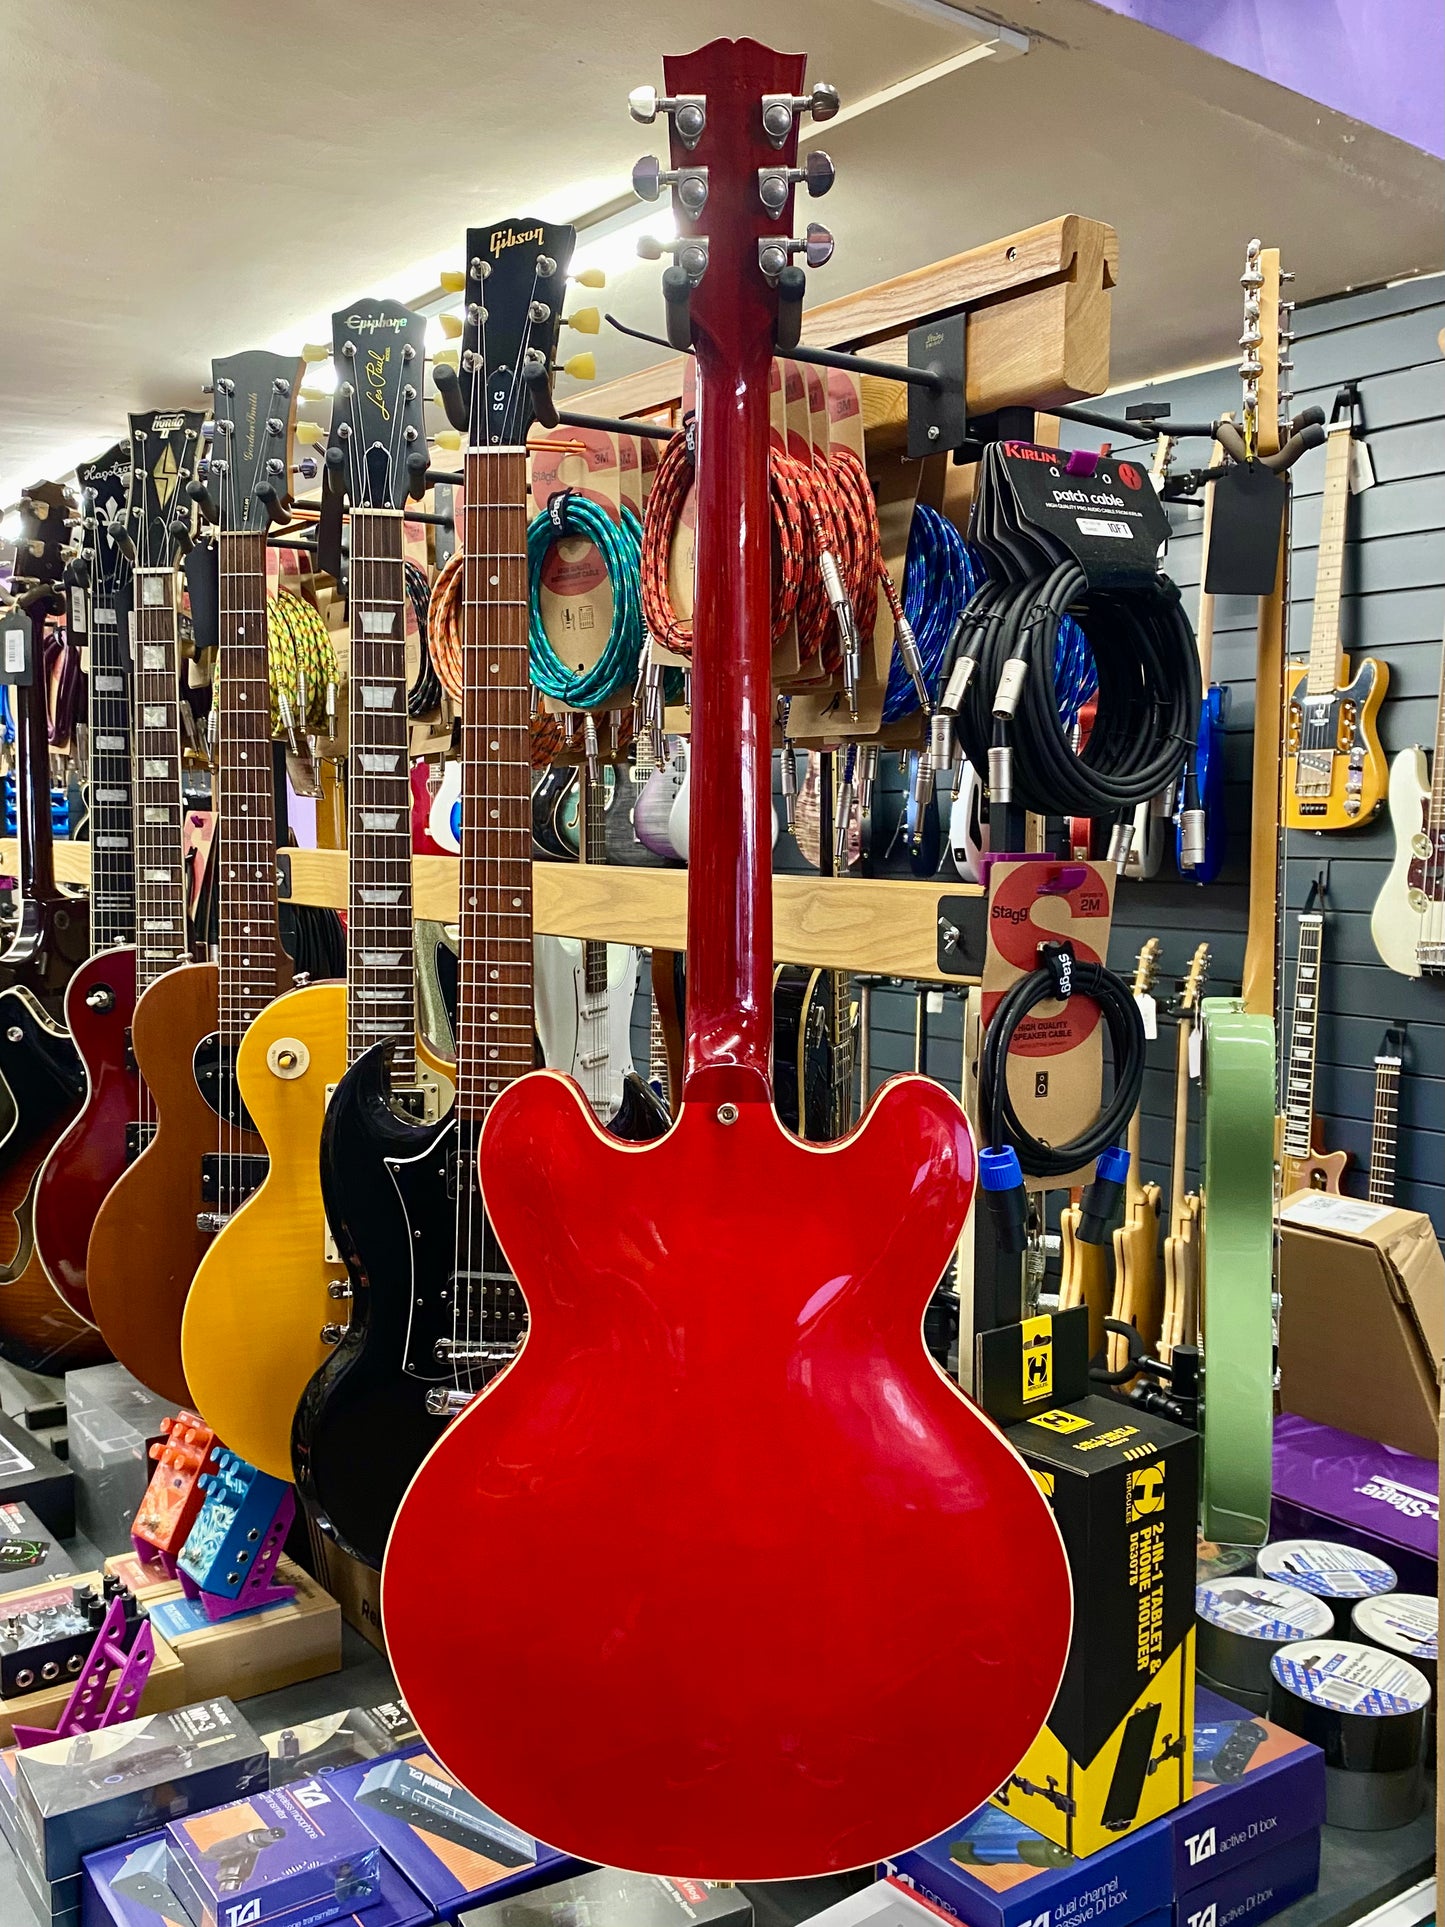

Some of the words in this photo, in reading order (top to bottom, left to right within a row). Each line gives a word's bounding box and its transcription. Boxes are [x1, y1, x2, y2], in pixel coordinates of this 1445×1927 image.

[490, 226, 544, 259] Gibson
[344, 313, 408, 335] Epiphone
[365, 349, 387, 388] Paul
[493, 391, 505, 411] SG
[1004, 443, 1057, 463] KIRLIN
[532, 468, 558, 485] Stagg
[1052, 489, 1089, 505] patch
[1090, 492, 1125, 508] cable
[1107, 523, 1129, 535] 10FT
[991, 906, 1028, 925] Stagg
[1080, 899, 1100, 912] 2M
[1058, 953, 1072, 994] Stagg
[1013, 1031, 1047, 1042] SPEAKER
[1048, 1029, 1072, 1039] CABLE
[1018, 1022, 1036, 1032] HIGH
[1038, 1021, 1068, 1031] QUALITY
[1129, 1532, 1139, 1586] DG307B
[1138, 1526, 1152, 1593] PHONE
[1152, 1522, 1165, 1582] 2-IN-1
[1151, 1585, 1164, 1652] TABLET
[1137, 1595, 1151, 1672] HOLDER
[1149, 1658, 1162, 1675] &
[187, 1706, 217, 1732] MP-3
[210, 1703, 232, 1726] NUX
[1184, 1827, 1216, 1866] TGI
[1219, 1833, 1246, 1853] active
[1248, 1823, 1258, 1838] DI
[1260, 1817, 1277, 1832] box
[1055, 1897, 1077, 1920] dual
[1079, 1876, 1118, 1907] channel
[1096, 1898, 1107, 1915] DI
[1109, 1890, 1128, 1908] box
[1219, 1905, 1245, 1926] active
[1246, 1896, 1256, 1911] DI
[1257, 1888, 1273, 1904] box
[226, 1898, 261, 1926] TGI
[302, 1906, 340, 1926] transmitter
